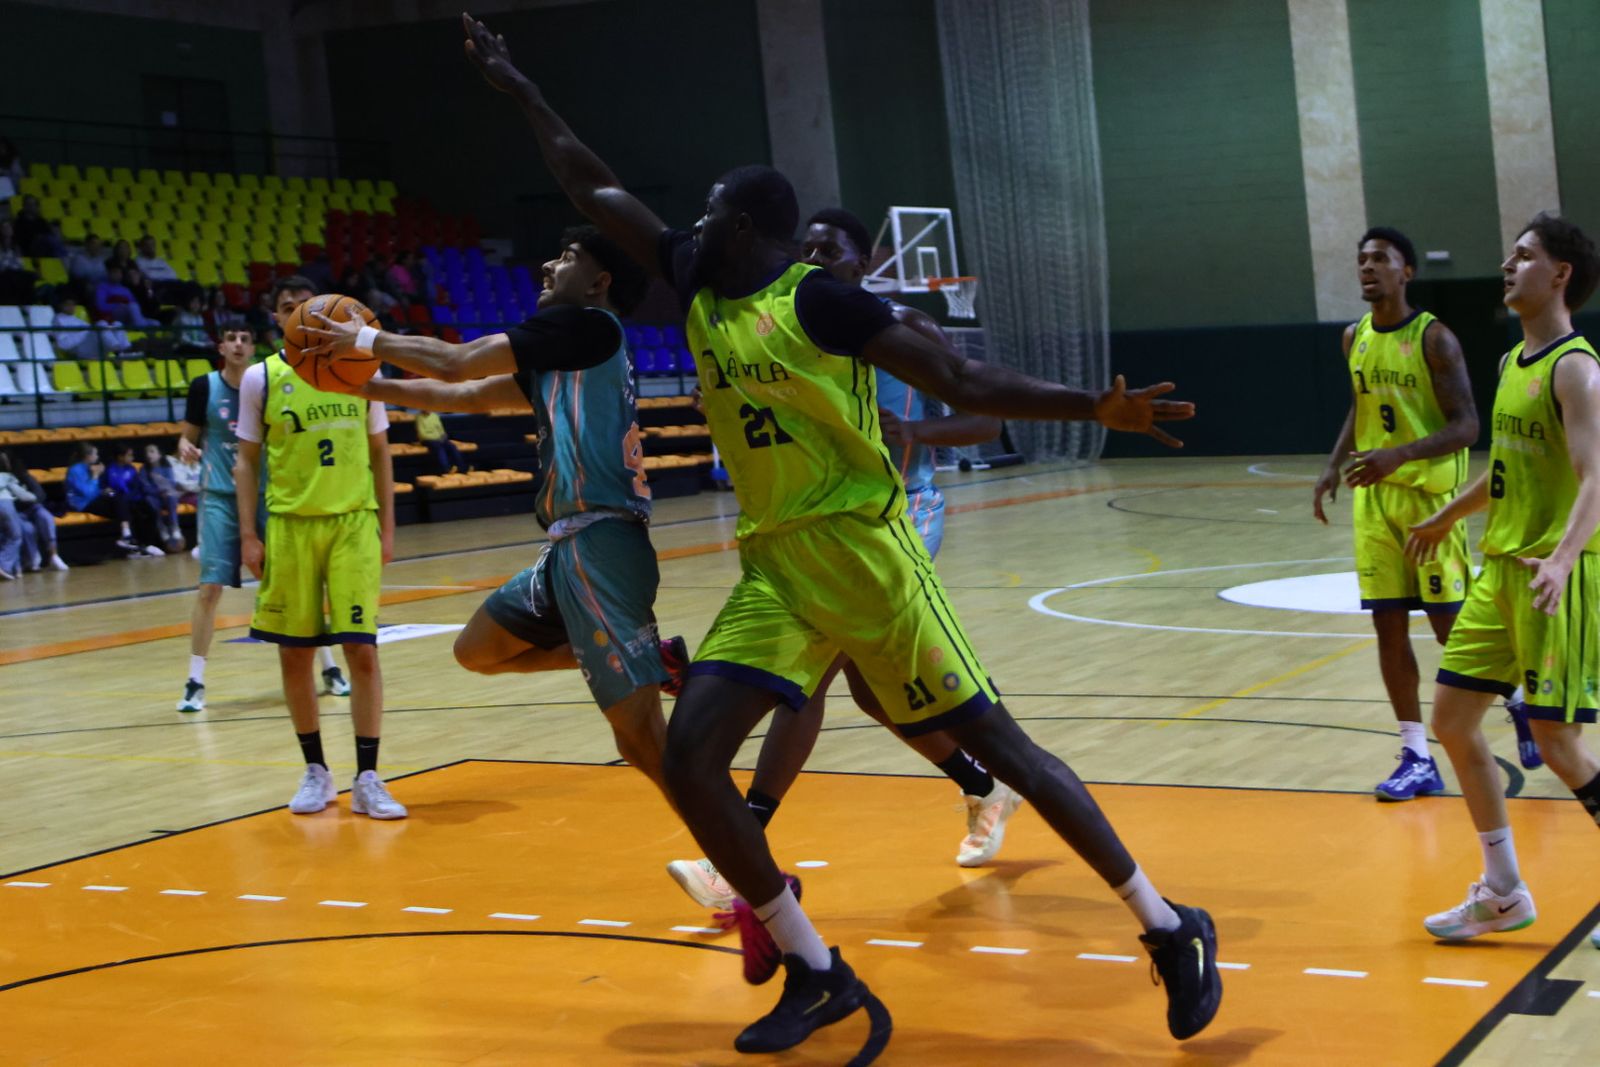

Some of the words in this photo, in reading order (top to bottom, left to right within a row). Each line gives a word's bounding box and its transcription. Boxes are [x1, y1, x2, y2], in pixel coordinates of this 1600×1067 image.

[1371, 366, 1417, 388] ÁVILA
[306, 403, 360, 421] ÁVILA
[1380, 404, 1396, 433] 9
[739, 403, 794, 449] 21
[317, 438, 336, 467] 2
[1490, 458, 1506, 500] 6
[1429, 575, 1441, 594] 9
[350, 604, 364, 625] 2
[903, 676, 938, 712] 21
[1525, 669, 1538, 695] 6
